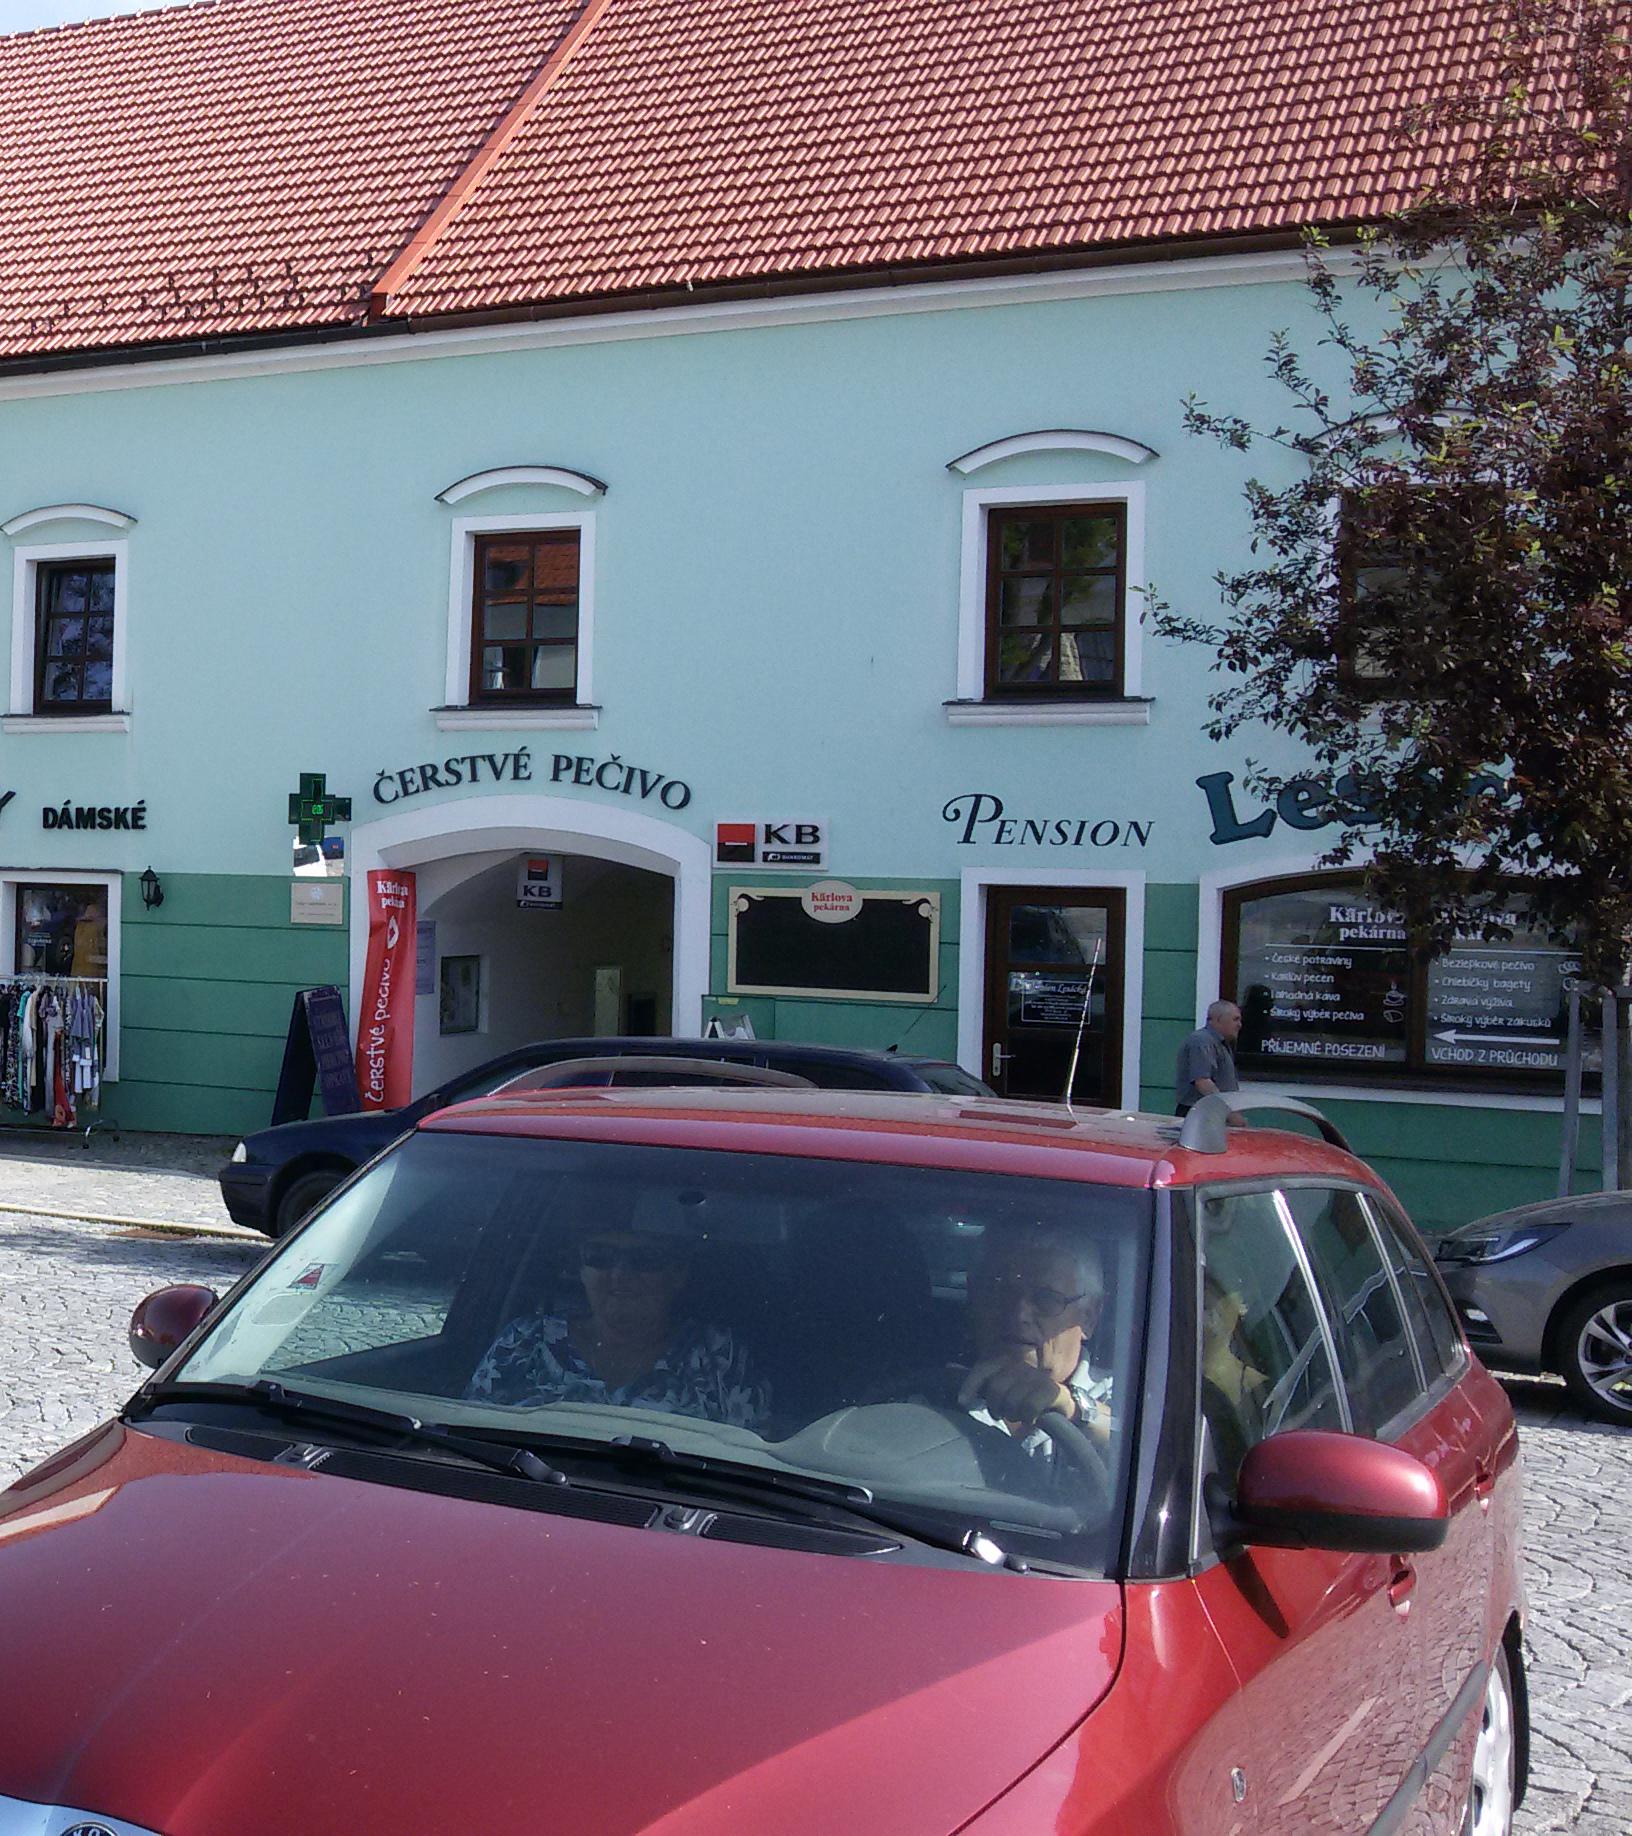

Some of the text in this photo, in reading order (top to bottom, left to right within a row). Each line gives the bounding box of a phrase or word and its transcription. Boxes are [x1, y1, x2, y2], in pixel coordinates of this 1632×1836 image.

[373, 746, 691, 810] ČERSTVÉ PEČIVO
[43, 799, 147, 830] DÁMSKÉ
[764, 824, 821, 844] KB
[523, 885, 552, 898] KB
[813, 903, 850, 912] pekárna
[1339, 926, 1406, 941] pekárna
[1431, 1047, 1558, 1066] VCHOD Z PRŮCHODU
